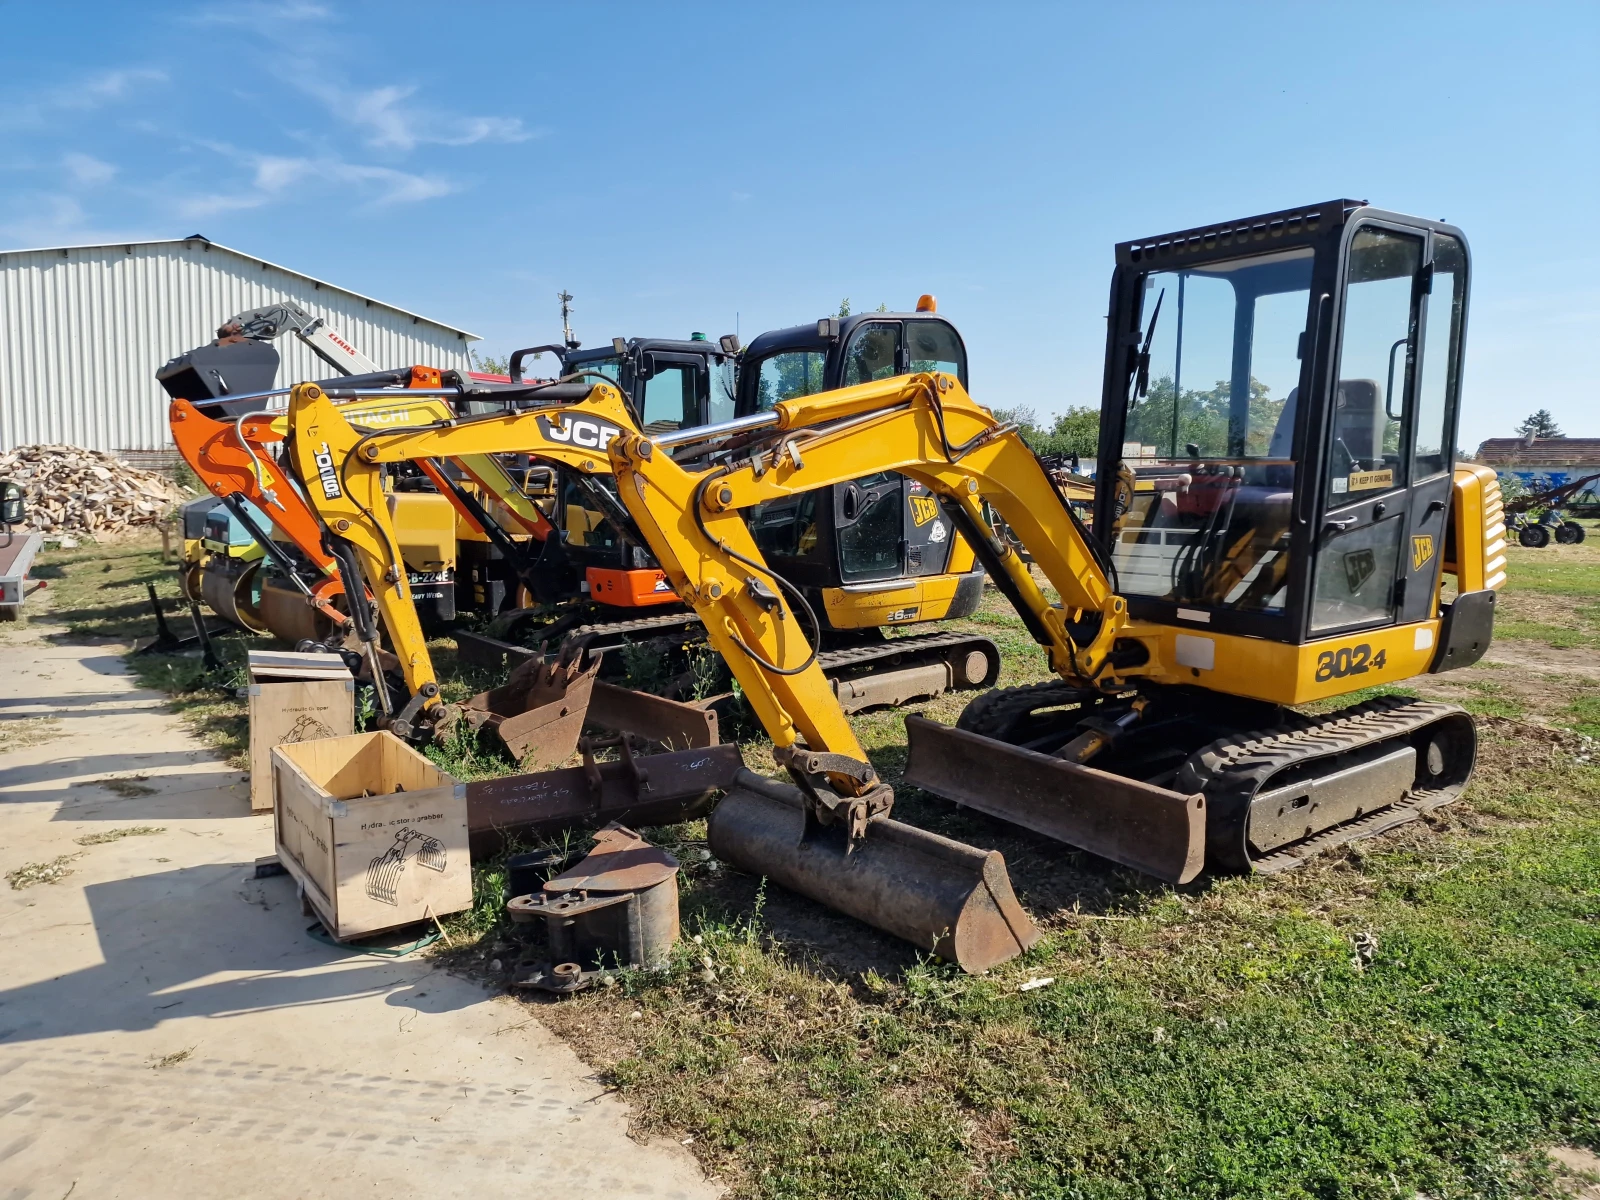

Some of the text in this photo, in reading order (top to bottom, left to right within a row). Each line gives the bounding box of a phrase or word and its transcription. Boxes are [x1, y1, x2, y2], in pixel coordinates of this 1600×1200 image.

[328, 333, 356, 356] CLAAS
[913, 497, 936, 524] JCB
[1414, 537, 1433, 568] JCB
[361, 819, 396, 831] Hydraic
